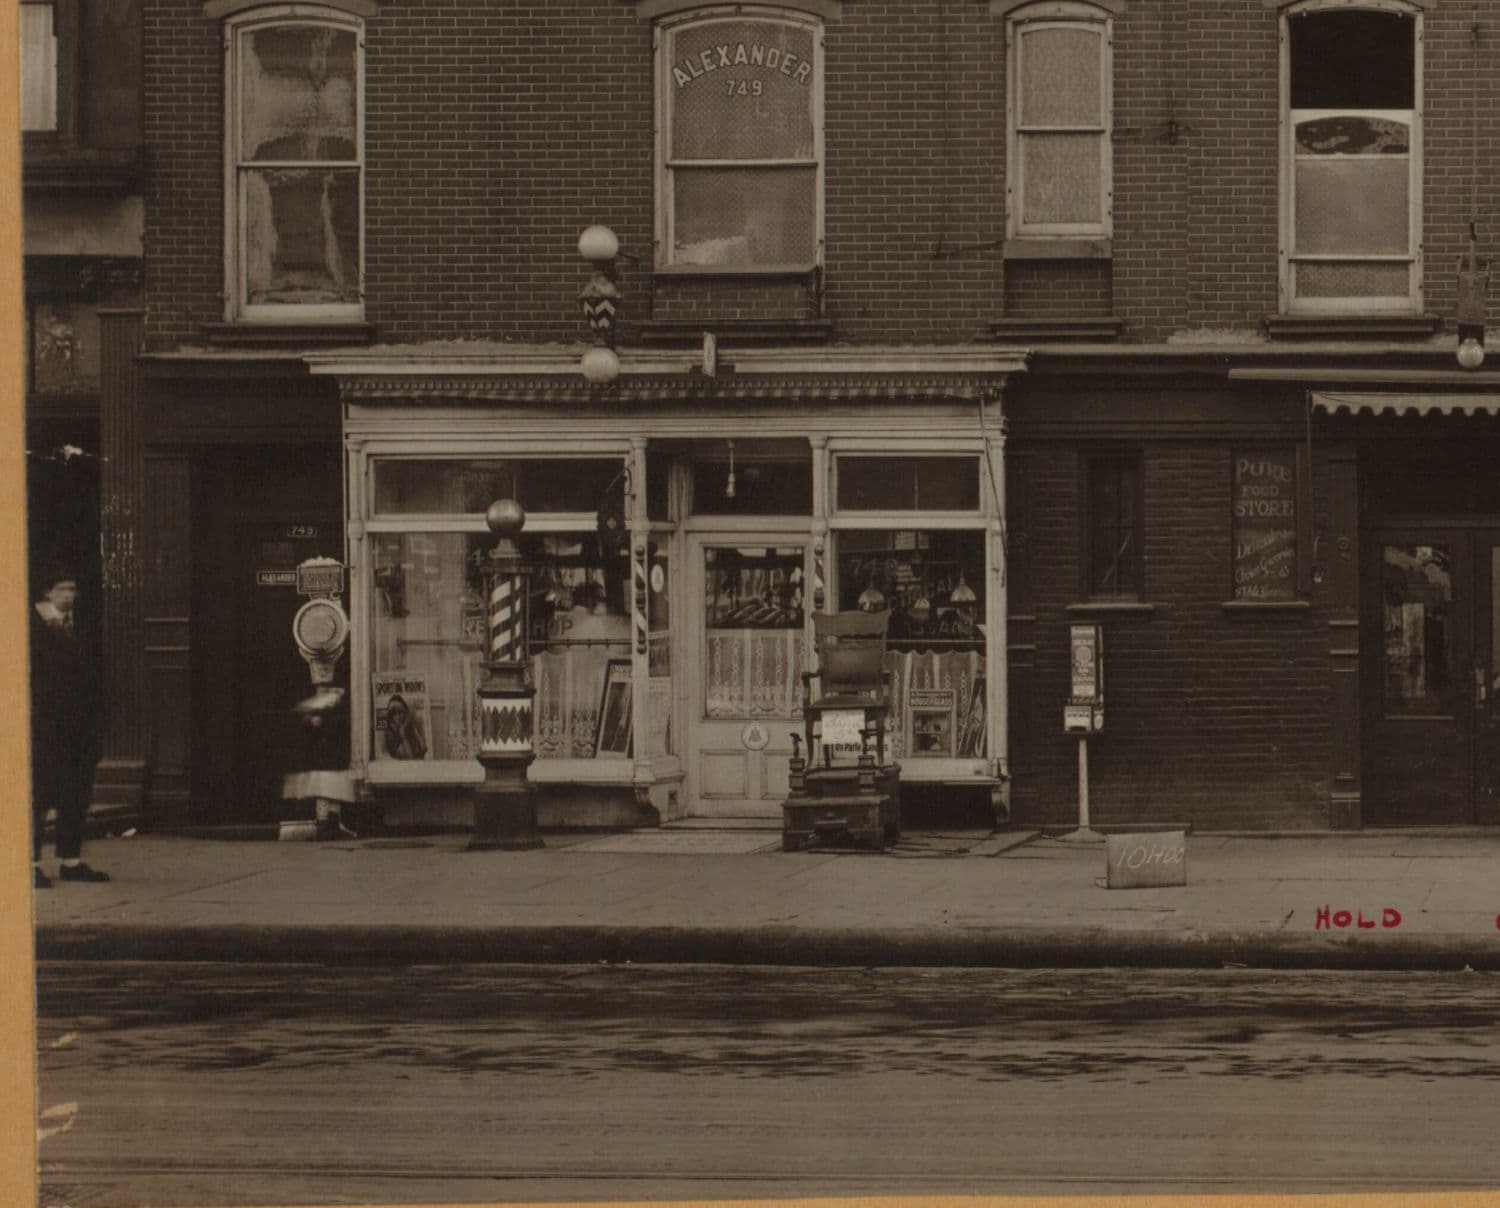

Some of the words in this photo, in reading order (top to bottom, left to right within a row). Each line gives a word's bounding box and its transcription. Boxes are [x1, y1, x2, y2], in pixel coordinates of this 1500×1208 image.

[672, 43, 811, 88] ALEXANDER
[725, 80, 763, 96] 749
[1236, 458, 1292, 484] PURE
[1235, 499, 1294, 517] STORE
